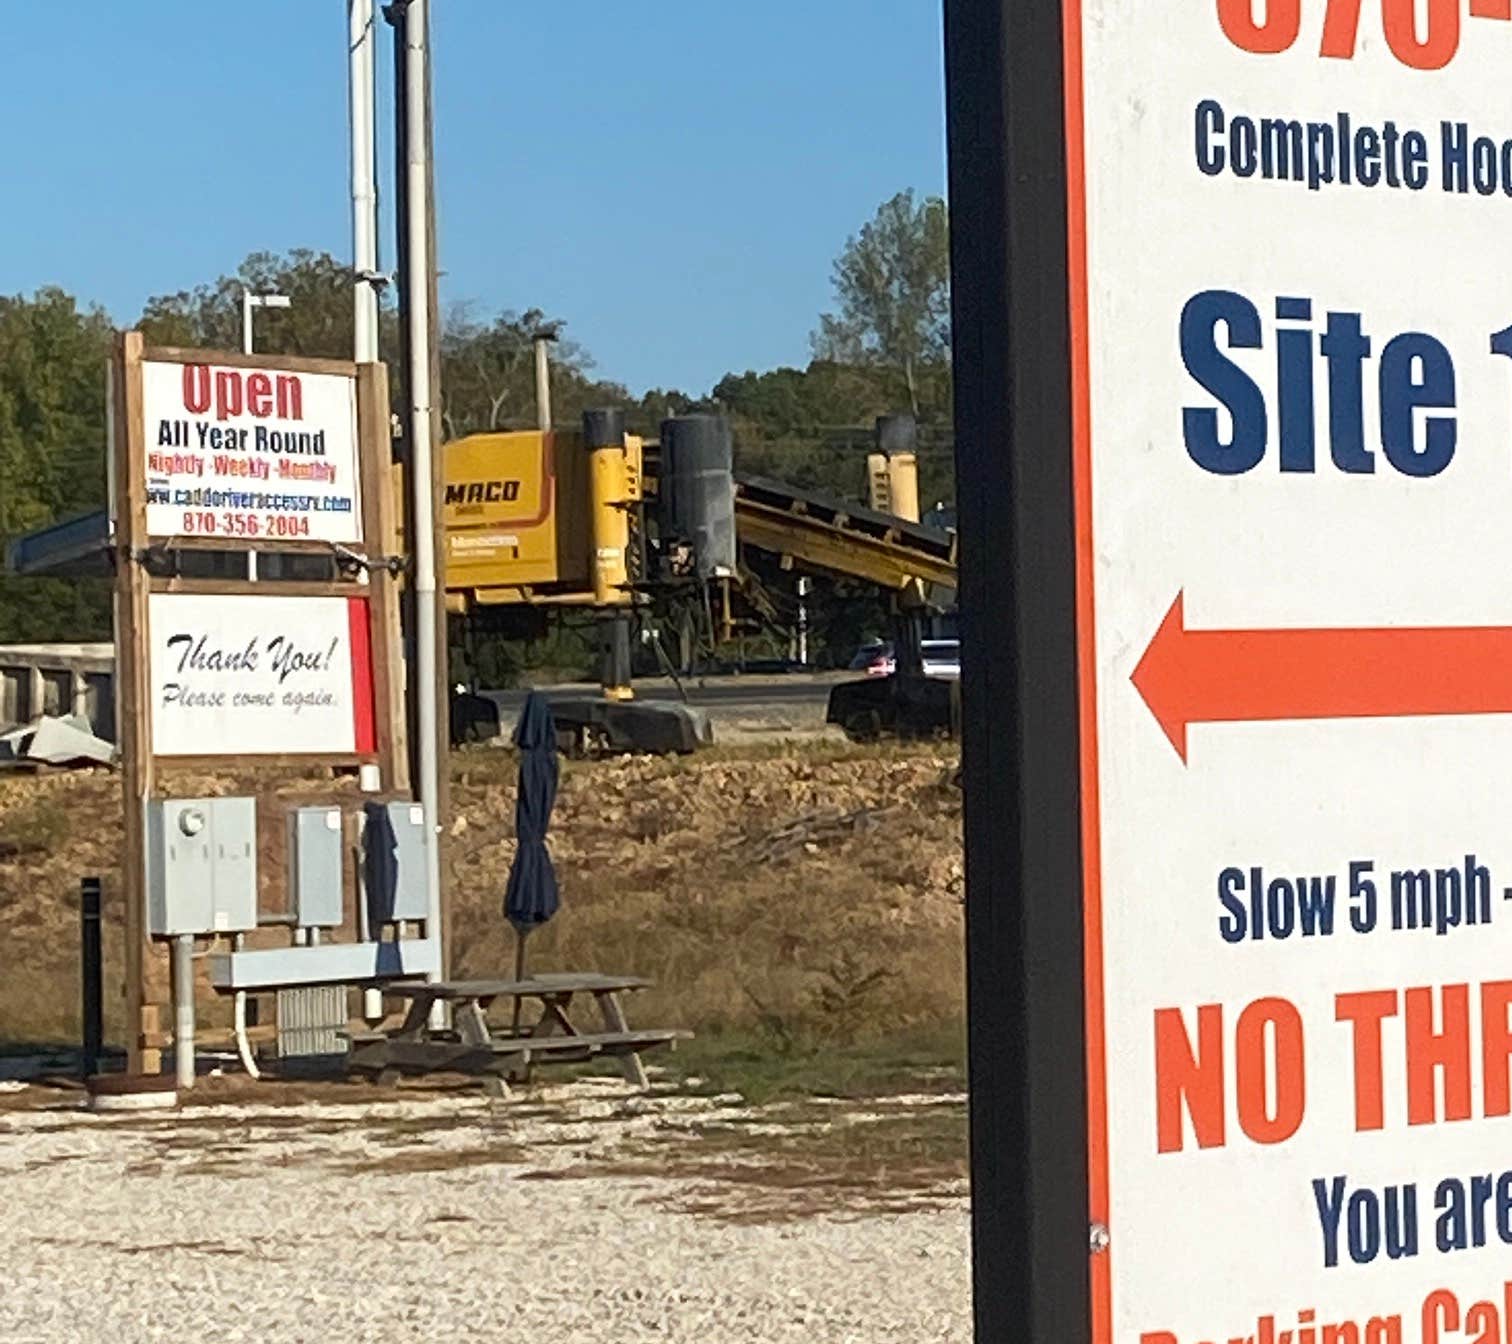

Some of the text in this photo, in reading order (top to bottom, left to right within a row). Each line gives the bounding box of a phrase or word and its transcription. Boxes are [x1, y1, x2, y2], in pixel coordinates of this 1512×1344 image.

[1195, 100, 1428, 191] Complete
[183, 364, 303, 420] Open
[1180, 290, 1456, 477] Site
[149, 453, 204, 477] Nightly
[158, 420, 325, 455] All Year Round
[183, 511, 309, 536] 870-356-2004
[167, 634, 339, 684] Thank You!
[163, 683, 337, 714] Please come again.
[1218, 868, 1335, 942] Slow
[1350, 861, 1376, 933] 5
[1391, 855, 1491, 935] mph
[1154, 997, 1305, 1154] NO
[1312, 1176, 1418, 1267] You
